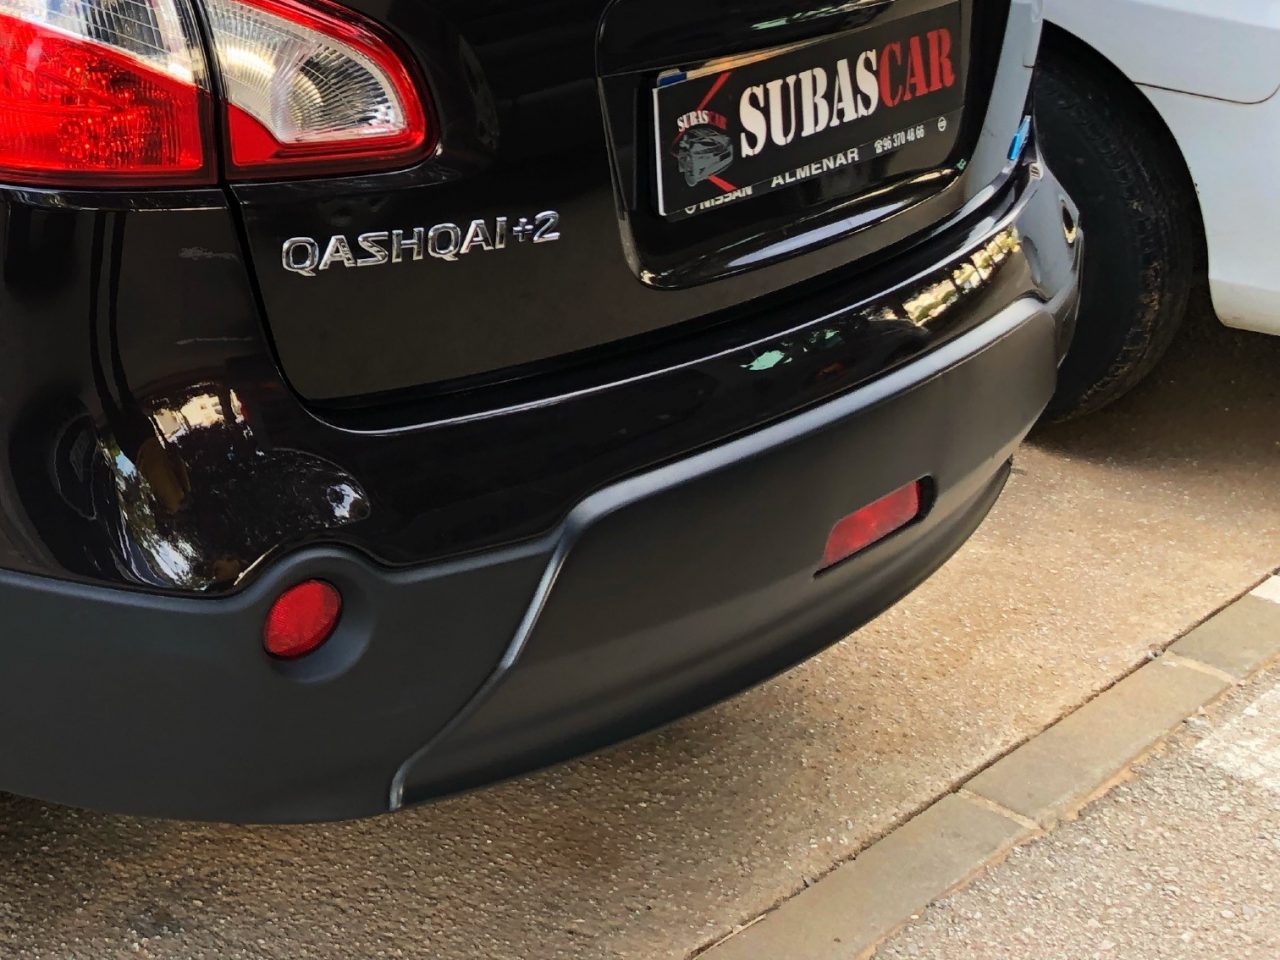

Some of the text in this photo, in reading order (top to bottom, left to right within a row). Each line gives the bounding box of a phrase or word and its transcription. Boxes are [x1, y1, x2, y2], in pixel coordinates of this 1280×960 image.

[739, 28, 956, 158] SUBASCAR
[771, 147, 859, 188] ALMENAR
[882, 135, 892, 151] 96
[893, 131, 906, 147] 370
[282, 210, 561, 277] QASHQAI+2
